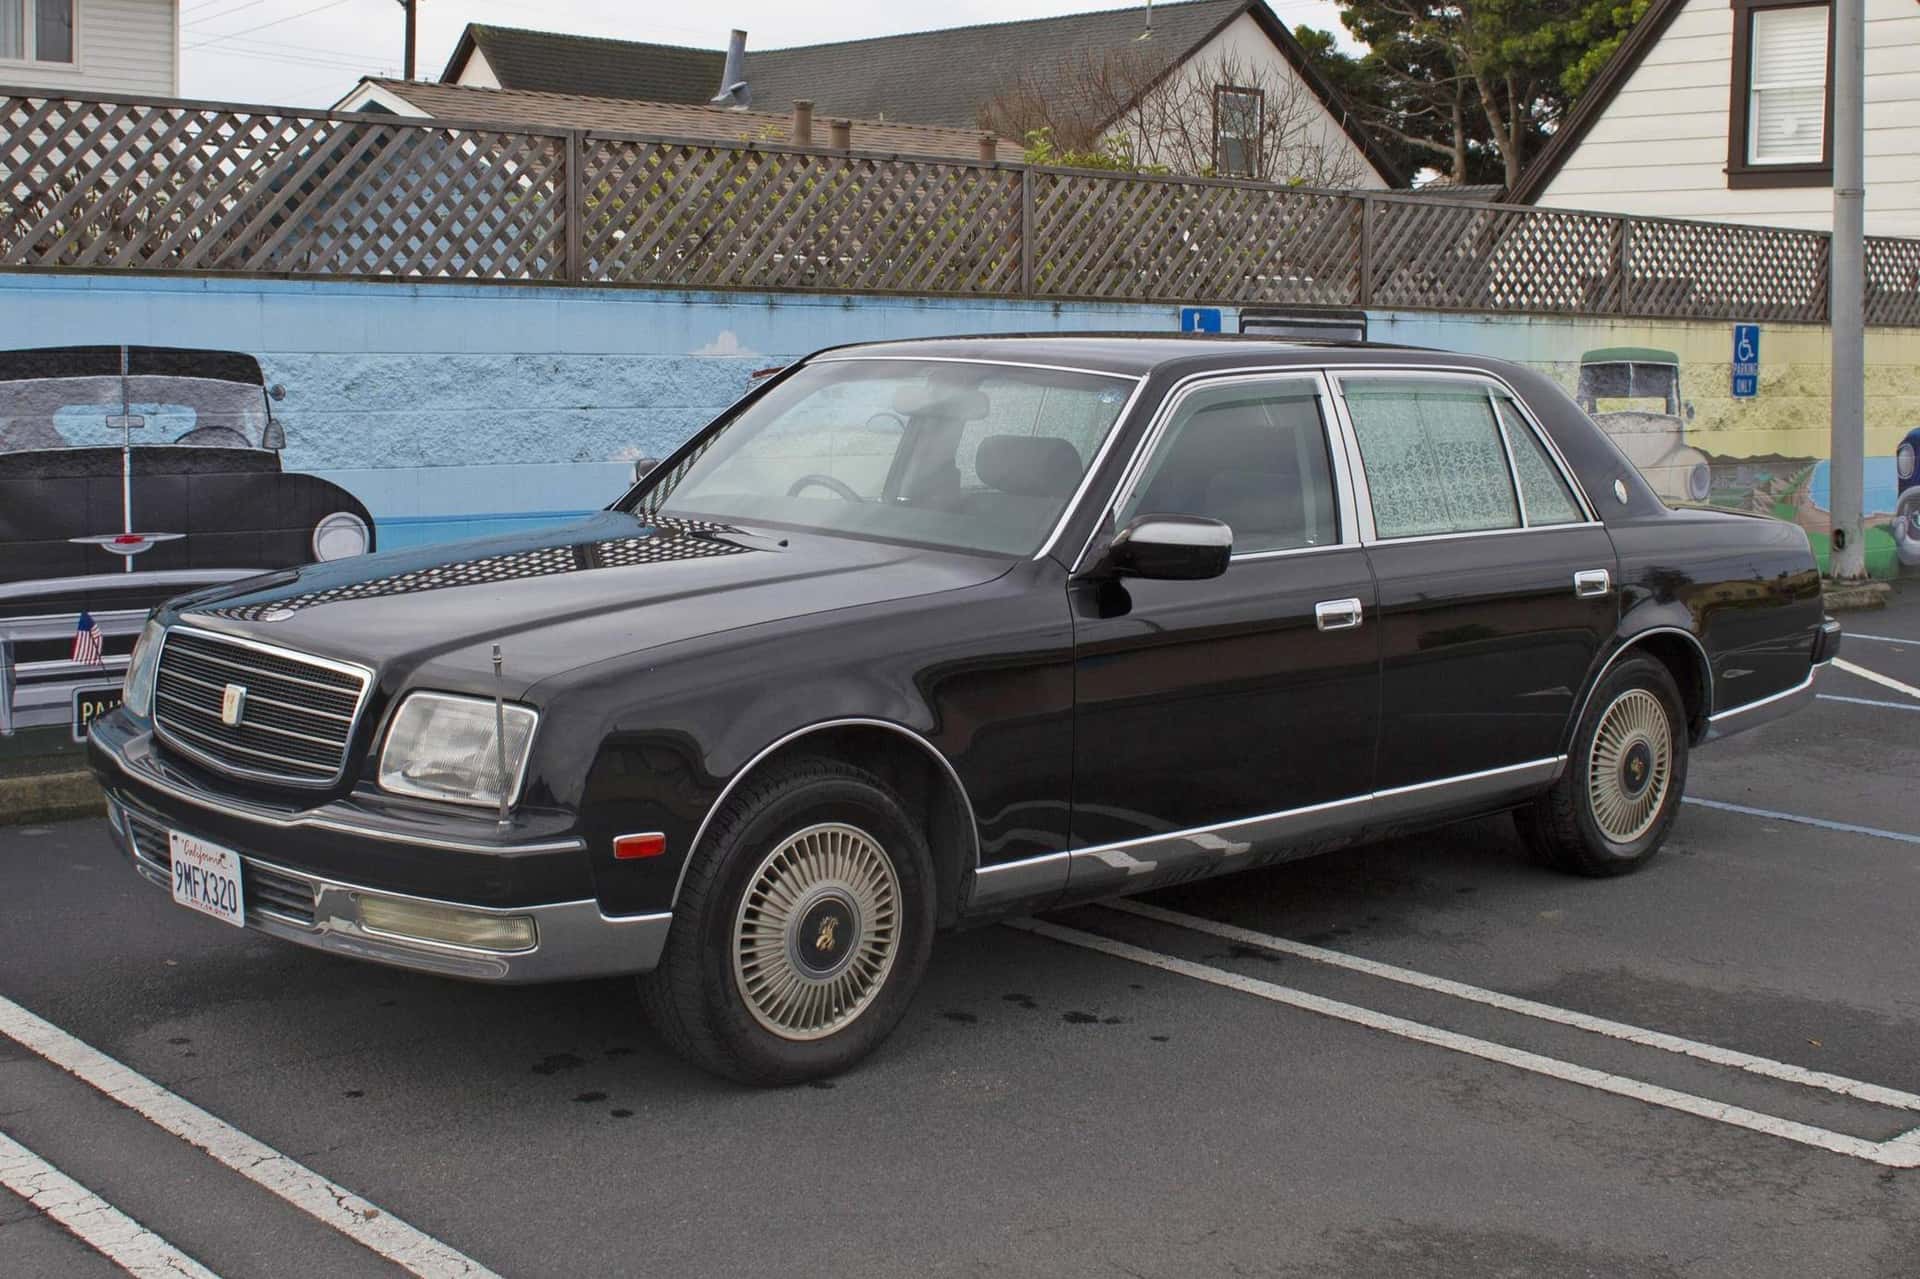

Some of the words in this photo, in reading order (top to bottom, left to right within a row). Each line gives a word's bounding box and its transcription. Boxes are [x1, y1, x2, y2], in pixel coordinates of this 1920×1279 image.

[1733, 362, 1758, 376] PARKING
[1736, 379, 1753, 393] ONLY
[176, 860, 237, 914] 9MFX320
